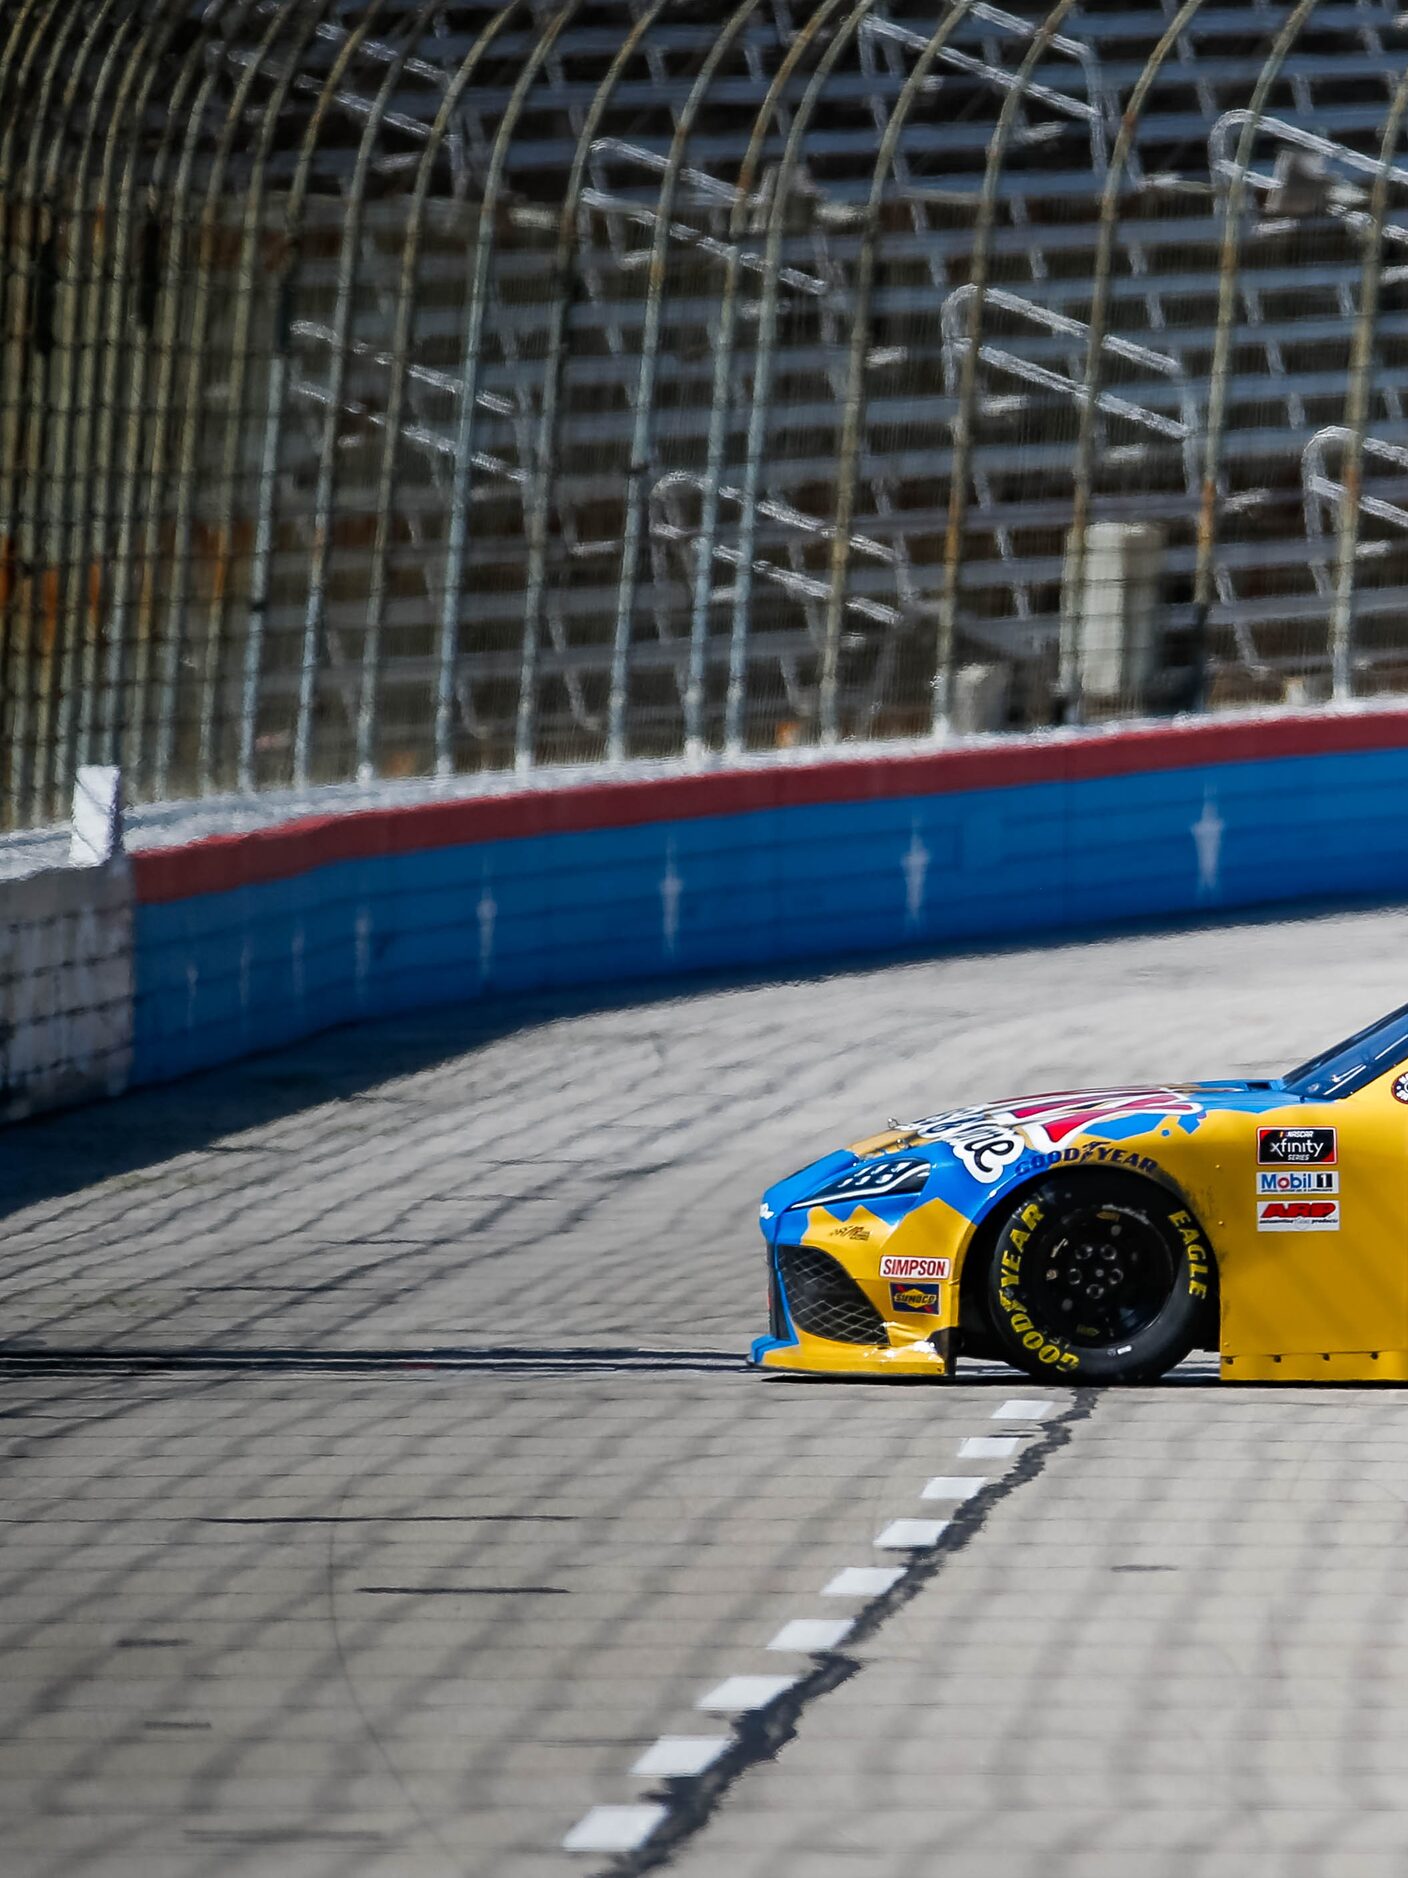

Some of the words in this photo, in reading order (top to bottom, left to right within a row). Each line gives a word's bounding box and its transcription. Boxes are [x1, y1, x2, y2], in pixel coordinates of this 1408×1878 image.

[1285, 1130, 1315, 1138] NASCAR
[1270, 1138, 1324, 1157] xfinity
[1015, 1141, 1159, 1176] GOODYEAR
[1287, 1153, 1311, 1162] SERIES
[1261, 1173, 1312, 1189] Mobil
[1260, 1202, 1337, 1218] ARP
[1168, 1209, 1209, 1299] EAGLE
[883, 1259, 946, 1276] SIMPSON
[999, 1203, 1080, 1372] GOODYEAR
[894, 1293, 937, 1305] SUNOCO
